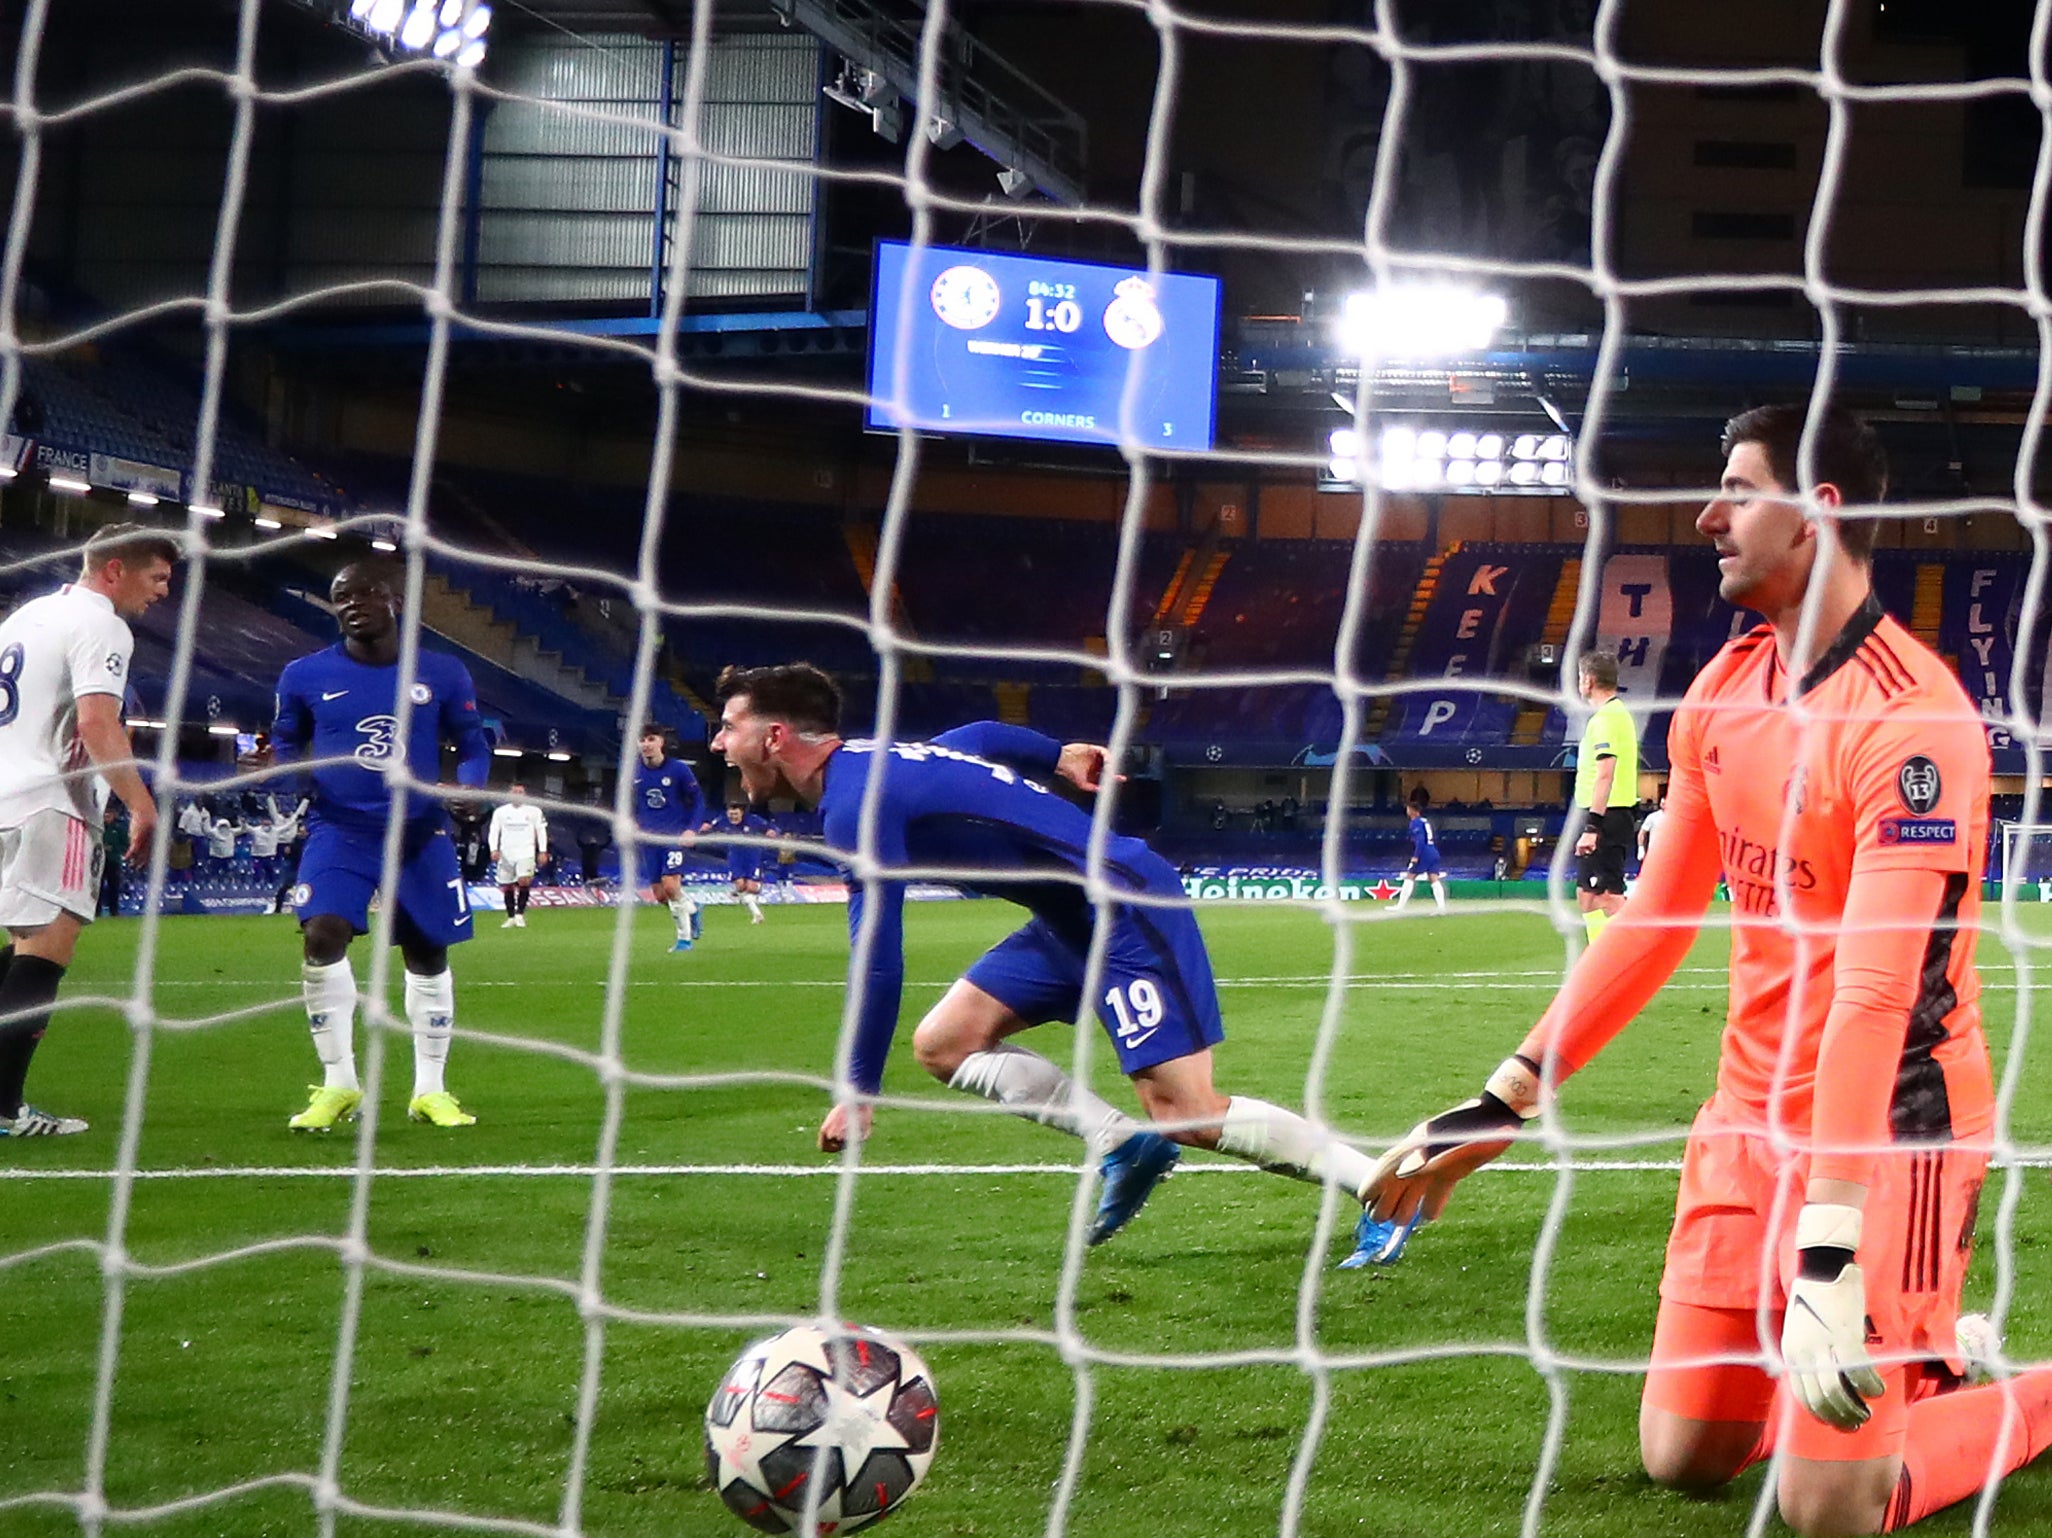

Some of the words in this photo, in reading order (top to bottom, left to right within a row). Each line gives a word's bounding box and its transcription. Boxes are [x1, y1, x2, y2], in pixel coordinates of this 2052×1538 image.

[1025, 298, 1081, 332] 1:0
[942, 404, 950, 418] 1
[1021, 410, 1095, 429] CORNERS
[1162, 423, 1172, 436] 3
[38, 446, 88, 470] FRANCE
[1618, 584, 1651, 693] TH
[1911, 783, 1930, 800] 13
[1901, 825, 1955, 839] RESPECT
[446, 877, 466, 913] 7
[1181, 878, 1361, 900] Heineken
[1105, 979, 1162, 1037] 19
